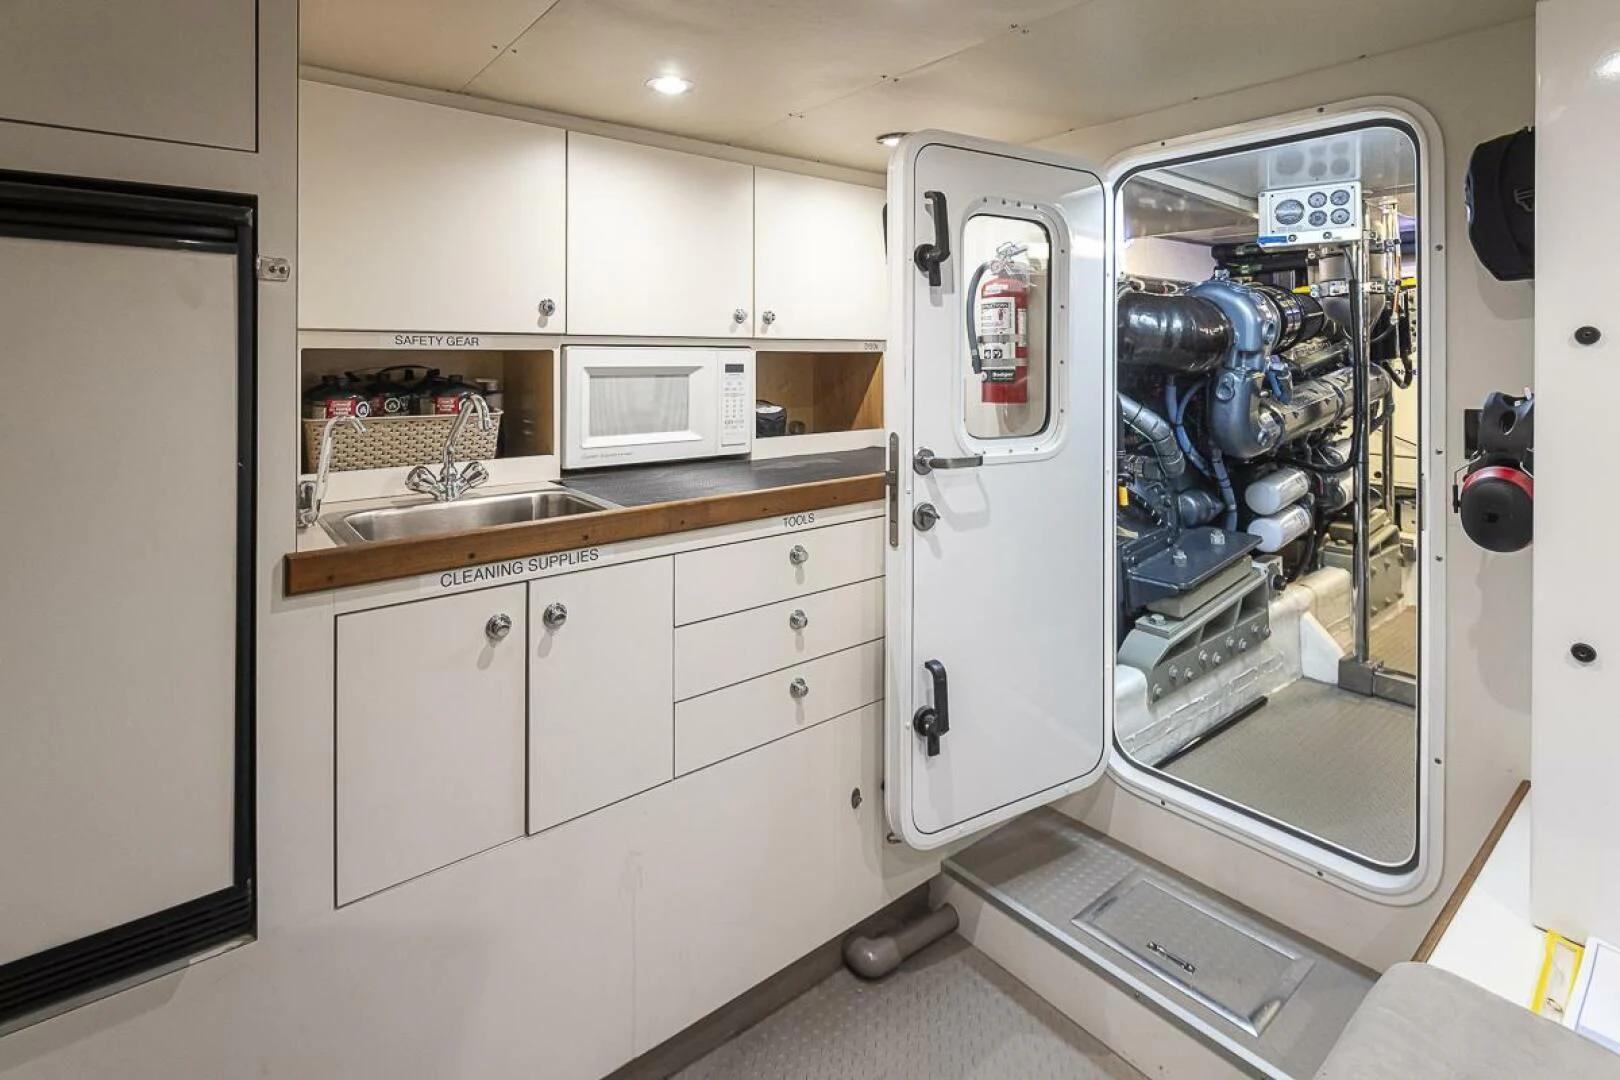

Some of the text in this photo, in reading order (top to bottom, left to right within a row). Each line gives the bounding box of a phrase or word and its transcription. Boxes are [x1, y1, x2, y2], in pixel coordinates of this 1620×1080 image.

[394, 334, 479, 347] SAFETY GEAR
[782, 512, 815, 528] TOOLS
[440, 548, 599, 588] CLEANING SUPPLIES
